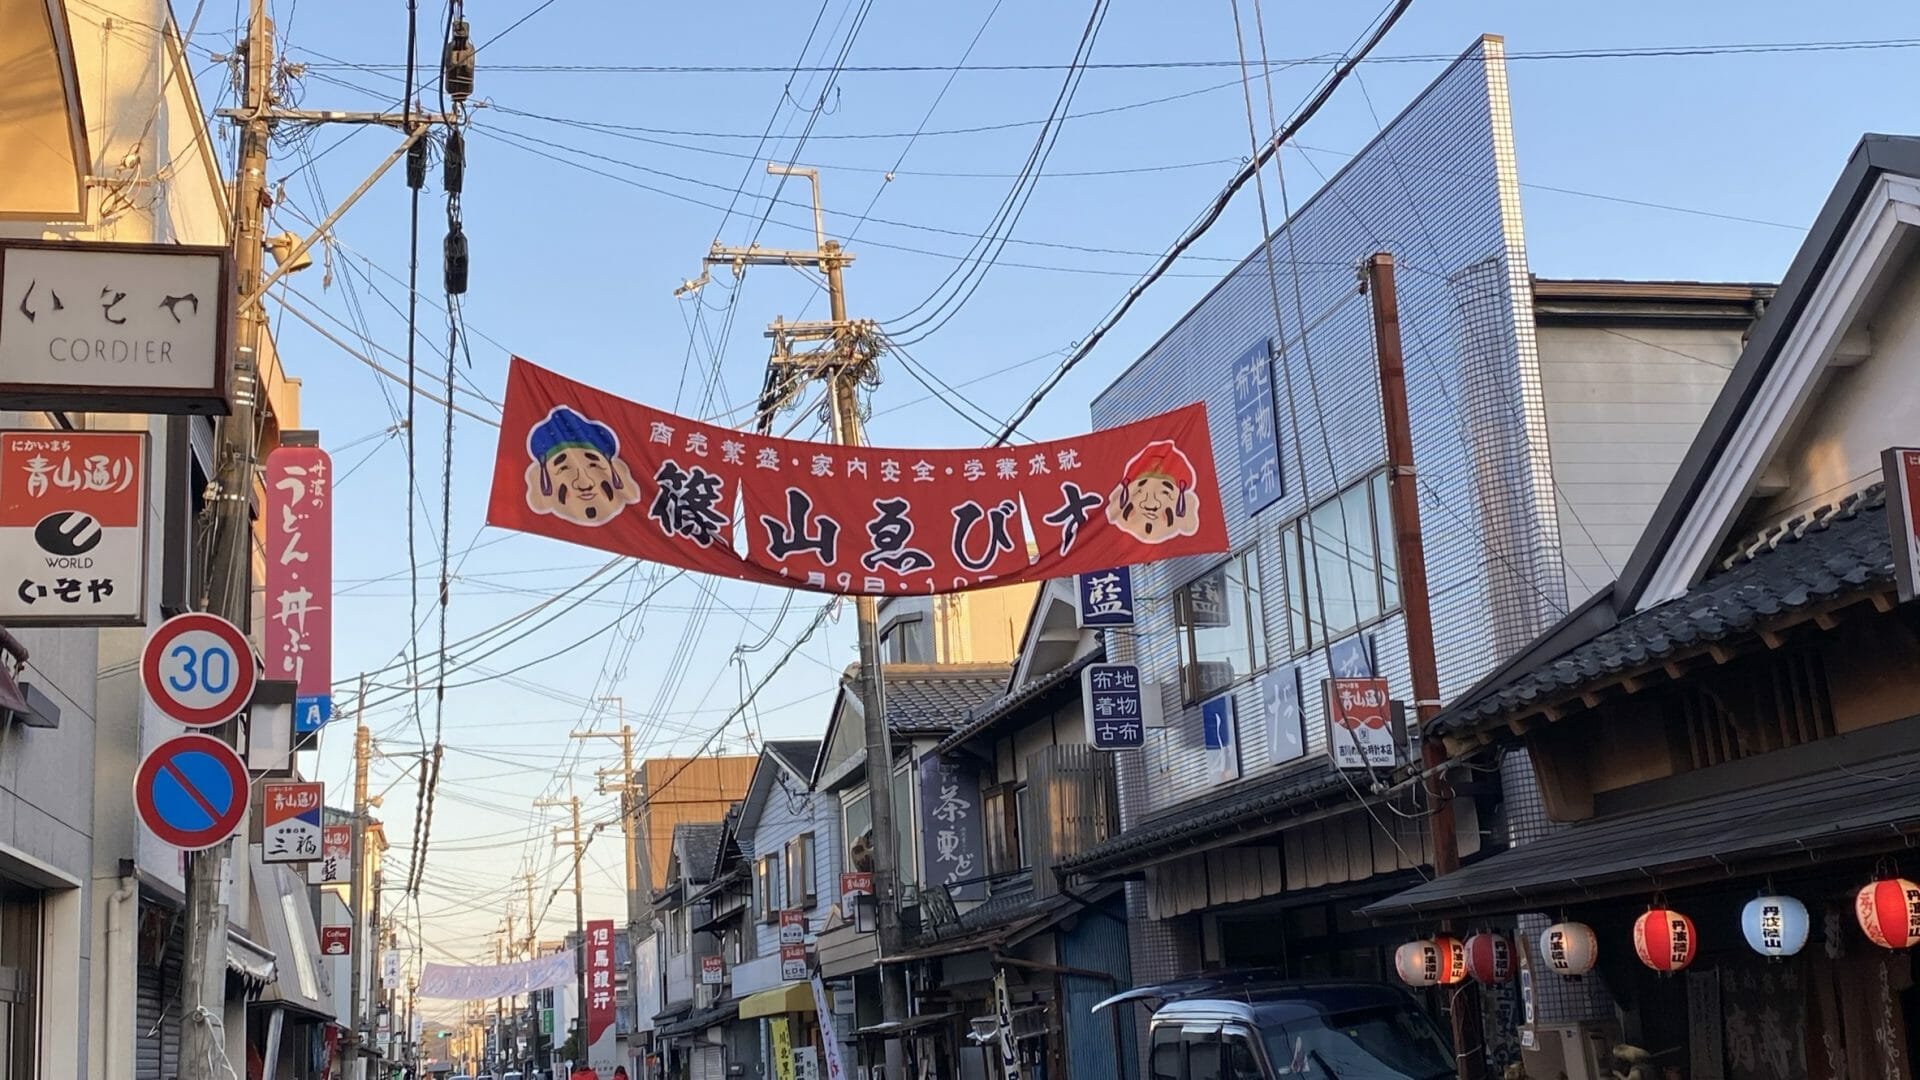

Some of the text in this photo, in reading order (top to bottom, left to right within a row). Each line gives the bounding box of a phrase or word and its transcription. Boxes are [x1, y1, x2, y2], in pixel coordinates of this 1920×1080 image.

[20, 278, 199, 324] いそや
[50, 337, 172, 363] CORDIER
[1235, 351, 1267, 401] 布地
[1241, 406, 1271, 453] 着物
[12, 440, 71, 452] にかいまち
[22, 453, 134, 498] 青山通り
[1245, 458, 1275, 504] 古布
[648, 459, 1103, 576] 篠山ゑびす
[45, 557, 94, 569] WORLD
[18, 578, 114, 605] いそや
[1085, 574, 1132, 618] 藍
[170, 645, 230, 694] 30
[1093, 670, 1136, 689] 布地
[1096, 696, 1137, 716] 着物
[1340, 690, 1386, 711] 青山通り
[1097, 722, 1139, 741] 古布
[274, 792, 318, 811] 青山通り
[268, 834, 317, 855] 三福
[593, 928, 610, 1009] 但馬銀行
